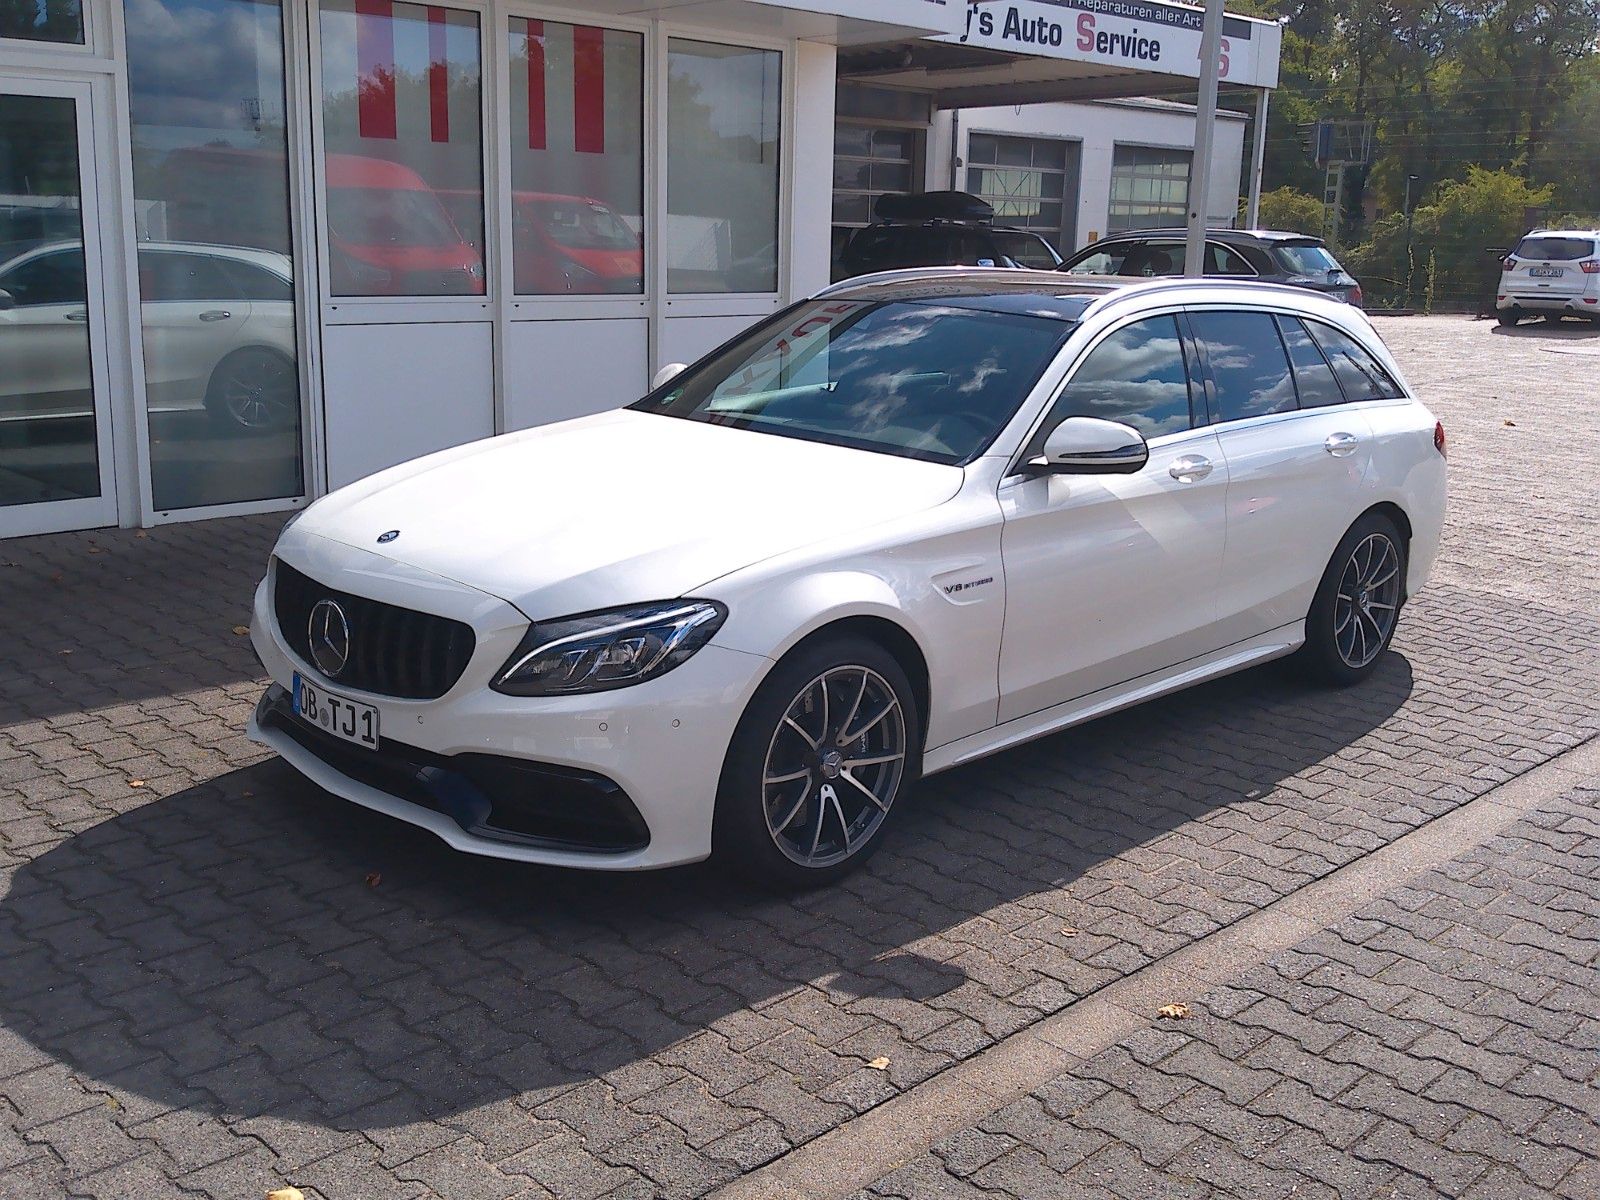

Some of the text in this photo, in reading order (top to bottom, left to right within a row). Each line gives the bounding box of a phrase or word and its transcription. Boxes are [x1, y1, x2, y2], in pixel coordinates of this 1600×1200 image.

[1155, 10, 1181, 23] aller
[1182, 13, 1201, 27] Art
[1002, 7, 1063, 47] Auto
[1076, 13, 1161, 62] Service
[944, 584, 963, 594] V8
[301, 682, 318, 720] OB
